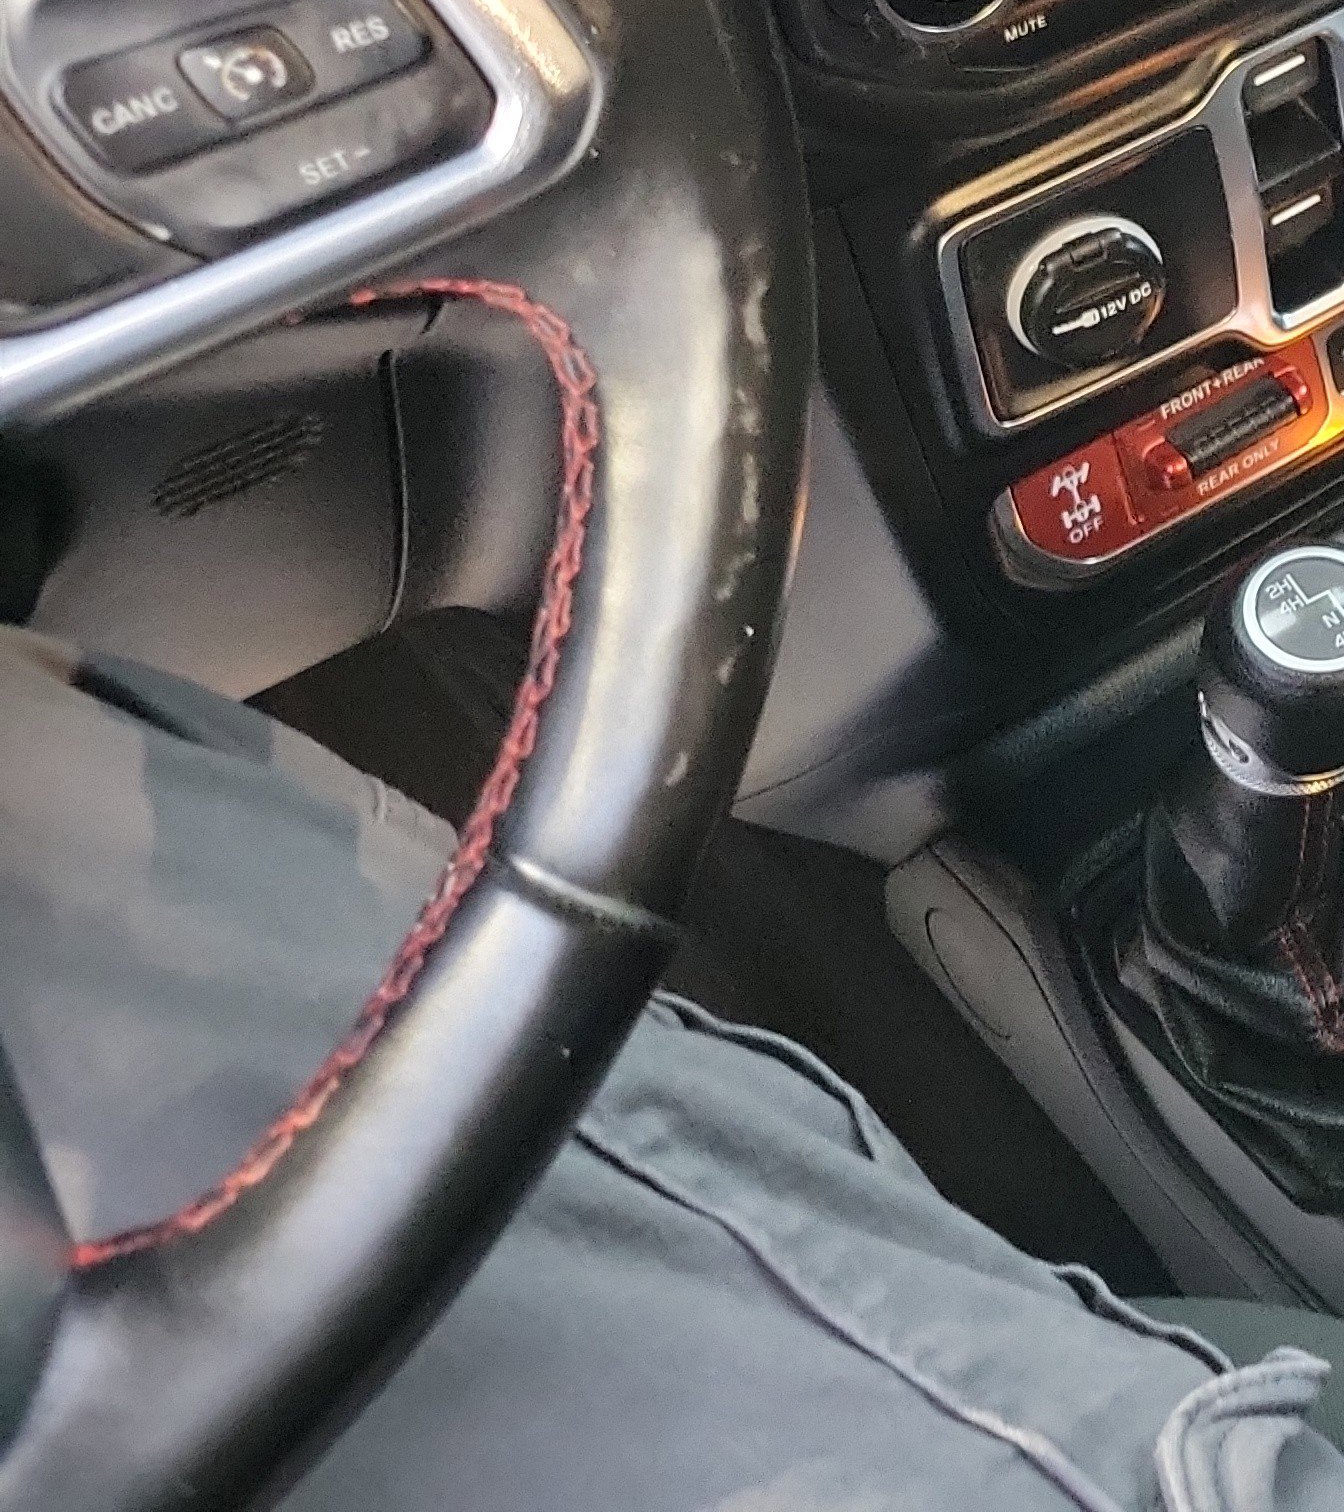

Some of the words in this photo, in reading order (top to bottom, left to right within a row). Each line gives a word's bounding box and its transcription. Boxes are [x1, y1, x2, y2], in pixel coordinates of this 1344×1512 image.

[330, 15, 389, 53] RES
[1004, 14, 1048, 43] MUTE
[91, 86, 179, 135] CANC
[1099, 296, 1128, 321] 12V
[1129, 281, 1152, 306] DC
[1197, 462, 1240, 496] REAR
[1241, 437, 1280, 469] ONLY
[1068, 516, 1104, 544] OFF
[1266, 577, 1292, 599] 2H
[1279, 594, 1304, 616] 4H
[1322, 611, 1341, 629] N
